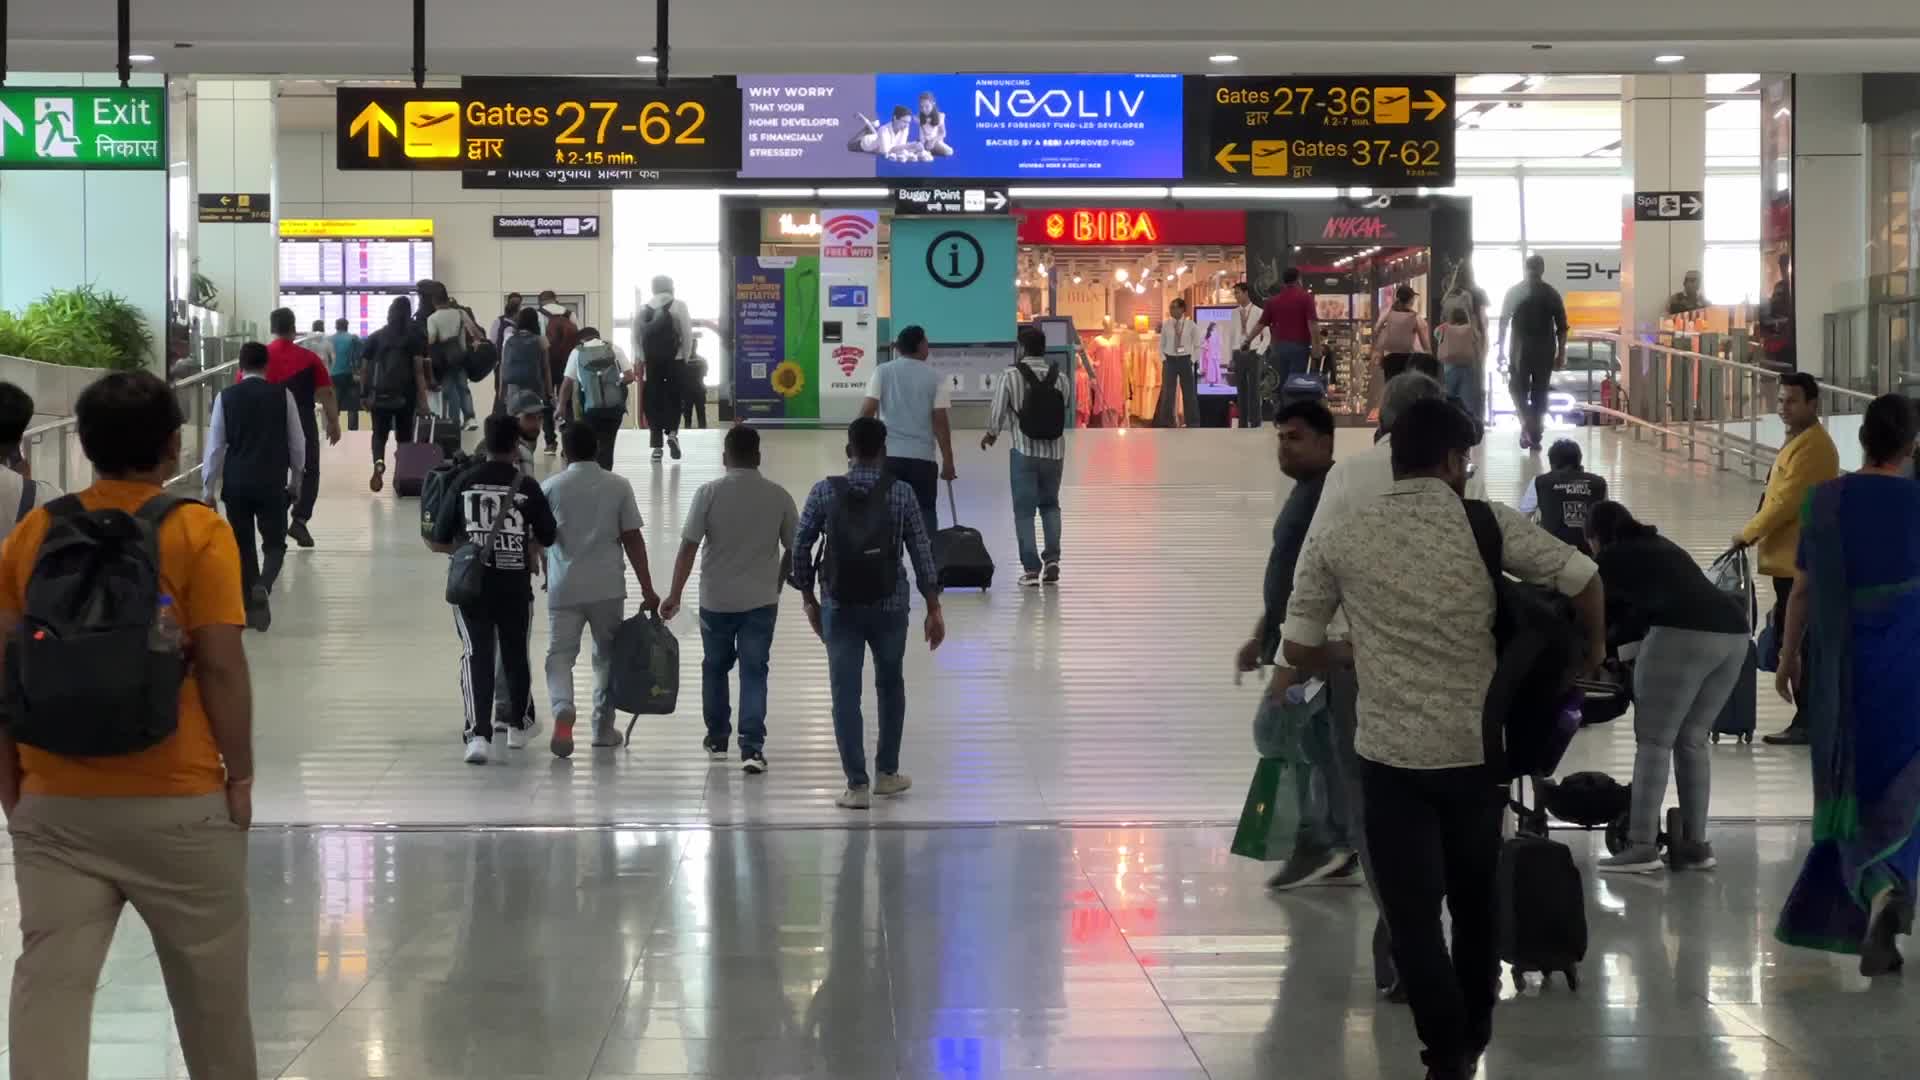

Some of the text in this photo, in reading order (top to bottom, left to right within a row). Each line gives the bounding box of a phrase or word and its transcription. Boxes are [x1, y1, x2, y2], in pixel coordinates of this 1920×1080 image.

[749, 87, 834, 97] WHY WORRY
[749, 103, 805, 112] THAT YOUR
[1215, 87, 1371, 116] Gates 27-36
[94, 97, 152, 125] Exit
[466, 101, 706, 145] Gates 27-62
[749, 118, 839, 127] HOME DEVELOPER
[749, 133, 824, 142] IS FINANCIALLY
[985, 138, 1020, 147] BACKED
[1022, 138, 1033, 147] BY
[1034, 138, 1041, 147] A
[1063, 138, 1109, 147] APPROVED
[95, 133, 159, 158] निकास
[466, 138, 505, 161] द्वार
[749, 148, 804, 157] STRESSED?
[1292, 139, 1441, 166] Gates 37-62
[568, 151, 639, 165] 2-15 min.
[899, 188, 961, 203] Buggy Point
[1637, 195, 1658, 208] Spa
[499, 217, 562, 229] Smoking Room
[1073, 210, 1157, 242] BIBA
[1322, 215, 1385, 240] NYKAA
